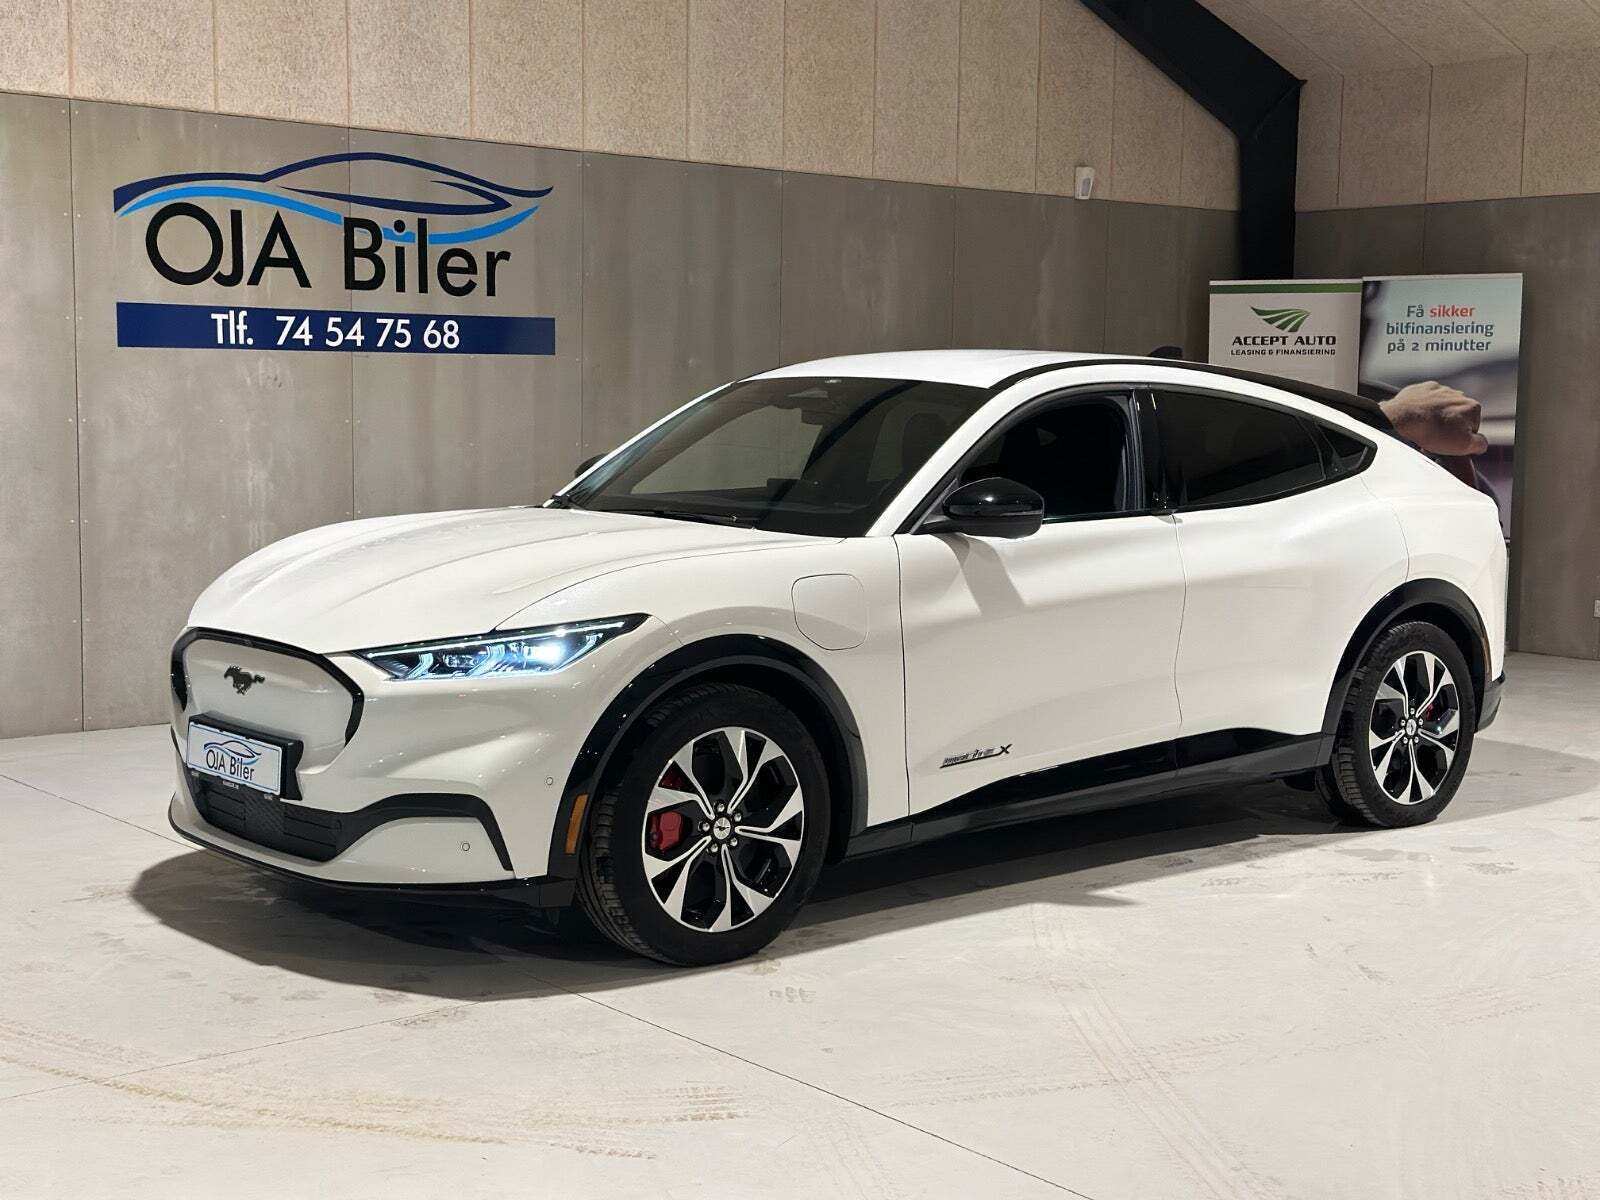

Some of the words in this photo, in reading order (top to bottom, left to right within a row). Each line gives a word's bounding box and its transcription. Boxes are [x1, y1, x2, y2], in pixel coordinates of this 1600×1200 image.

[145, 202, 312, 288] OJA
[343, 216, 511, 297] Biler
[1406, 304, 1424, 318] Få
[1429, 304, 1475, 318] sikker
[211, 310, 254, 345] Tlf.
[276, 315, 313, 346] 74
[325, 316, 365, 347] 54
[376, 318, 412, 348] 75
[423, 319, 460, 349] 68
[1386, 321, 1494, 338] bilfinansiering
[1232, 335, 1289, 346] ACCEPT
[1294, 335, 1337, 346] AUTO
[1387, 339, 1405, 354] på
[1411, 342, 1420, 352] 2
[1425, 339, 1491, 352] minutter
[1231, 348, 1266, 356] LEASING
[1276, 348, 1336, 356] FINANSIERING
[206, 749, 227, 773] OJA
[230, 755, 255, 781] Biler
